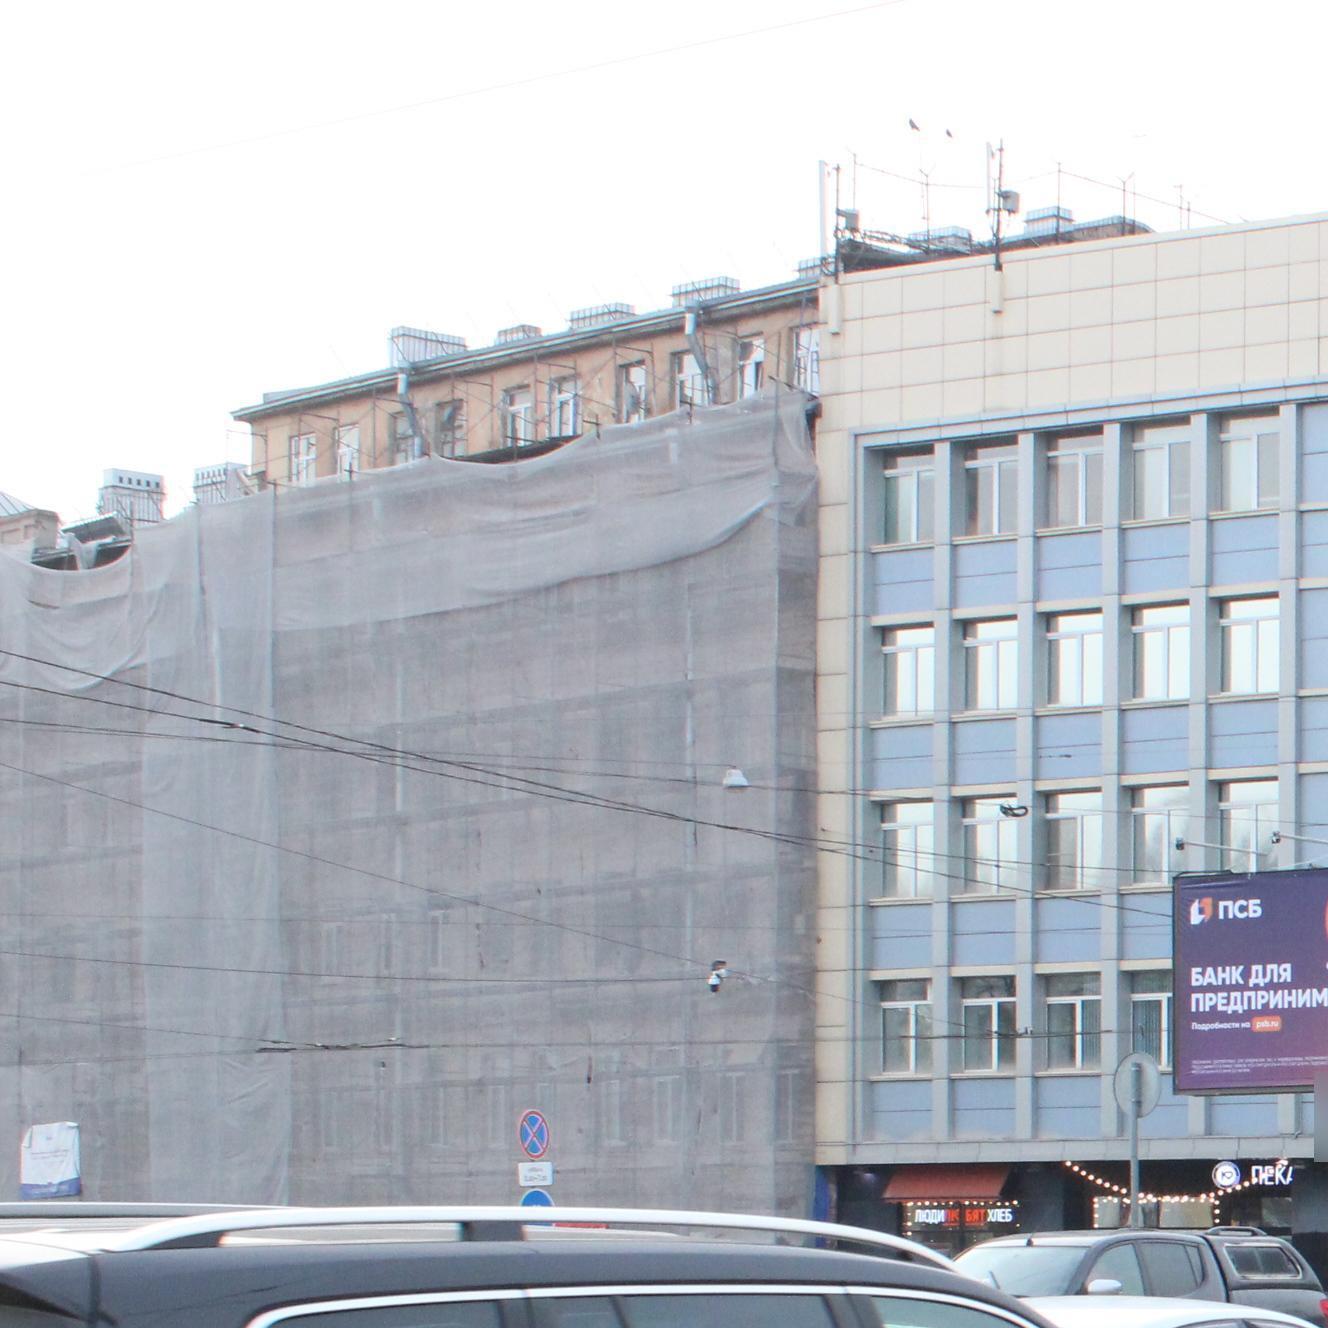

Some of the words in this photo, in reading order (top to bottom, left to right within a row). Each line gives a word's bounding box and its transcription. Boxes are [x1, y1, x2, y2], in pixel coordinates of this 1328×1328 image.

[1218, 899, 1262, 919] ПСБ
[1191, 964, 1244, 987] БАНК
[1248, 963, 1292, 987] ДЛЯ
[1191, 1022, 1240, 1031] Подробности
[915, 1208, 945, 1224] ЛЮДИ
[987, 1208, 1013, 1222] ХЛЕБ
